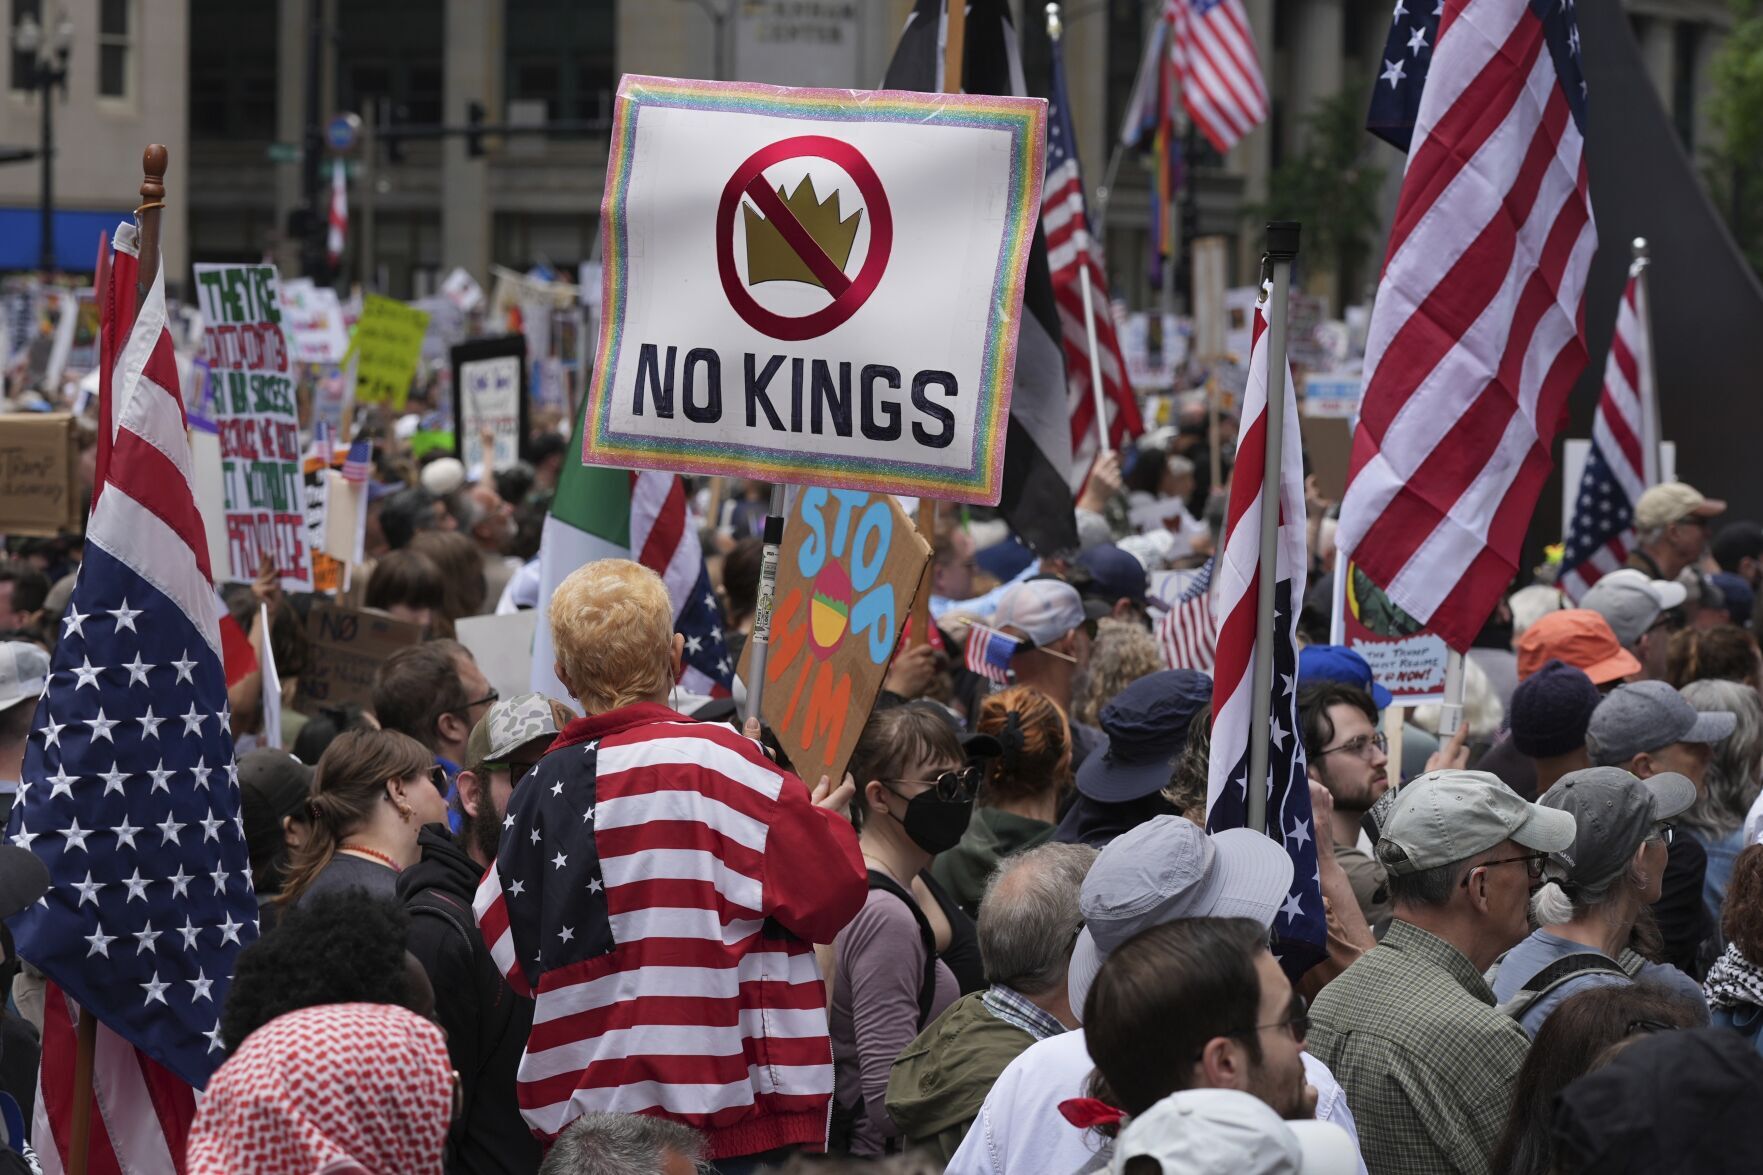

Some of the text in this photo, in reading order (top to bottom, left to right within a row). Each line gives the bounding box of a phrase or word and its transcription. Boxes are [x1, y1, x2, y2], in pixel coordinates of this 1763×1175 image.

[632, 343, 958, 448] NO KINGS
[798, 489, 895, 664] STOP
[767, 587, 851, 767] HIM
[1397, 669, 1432, 682] NOW!
